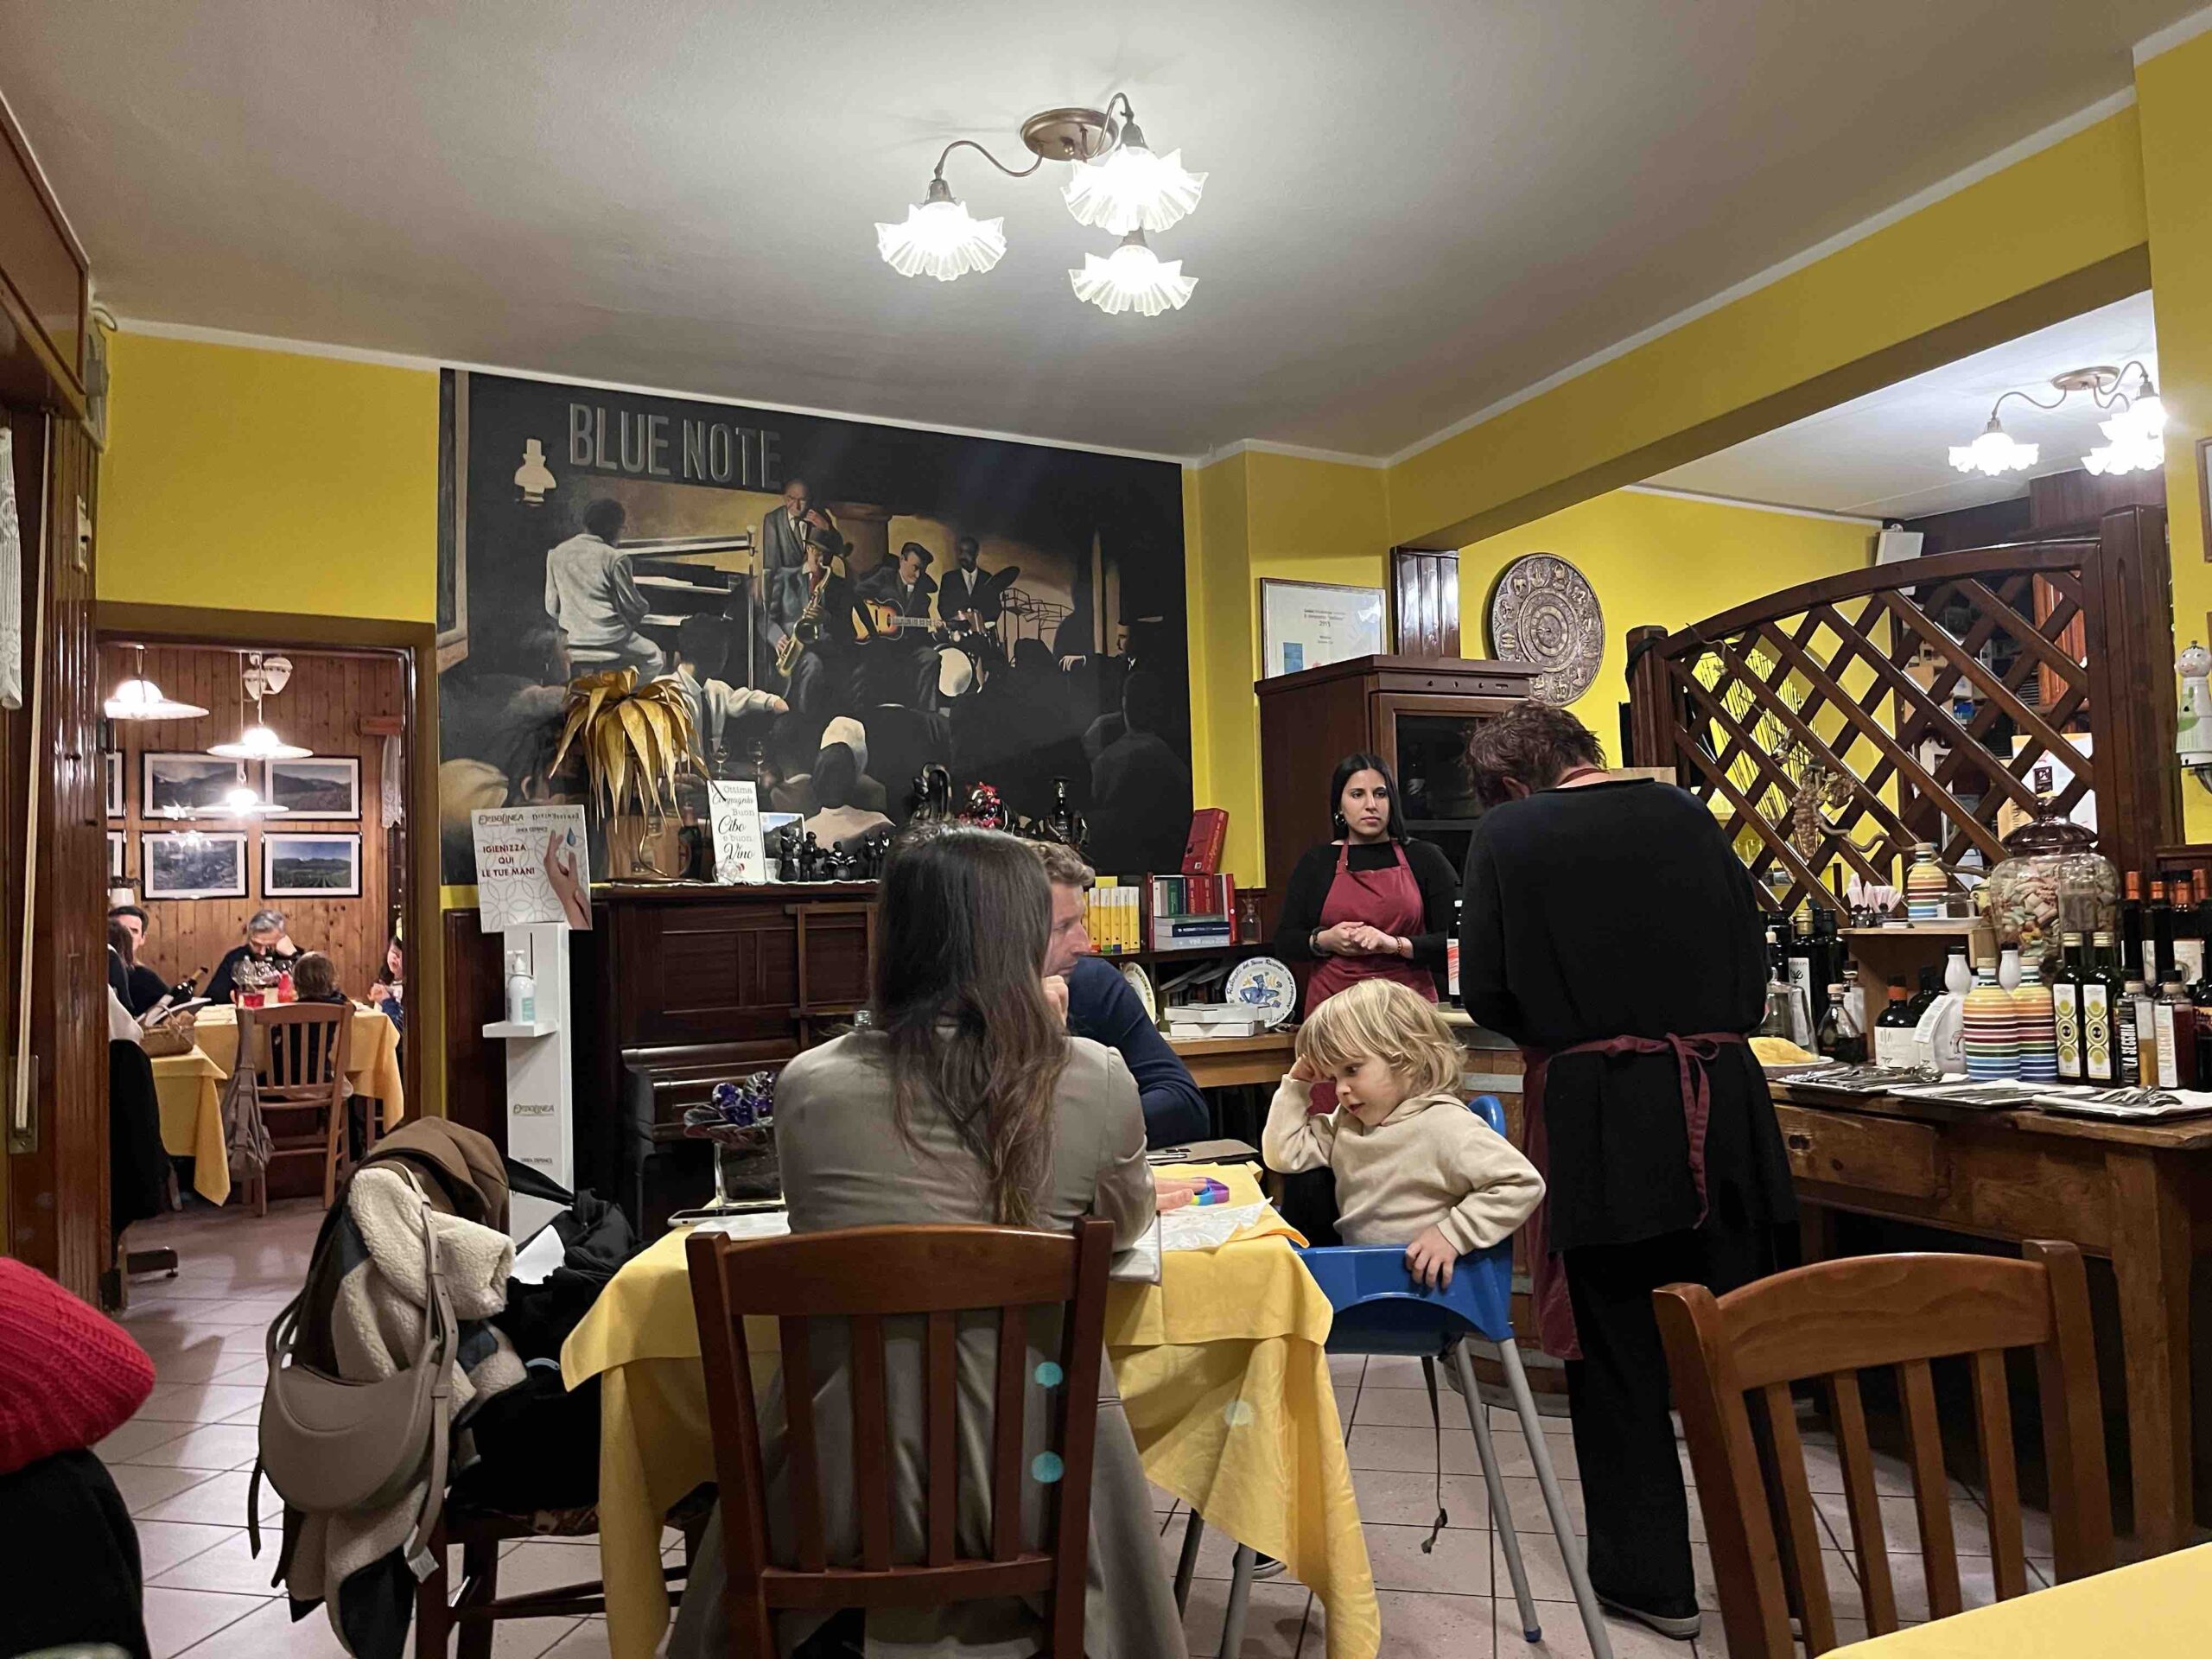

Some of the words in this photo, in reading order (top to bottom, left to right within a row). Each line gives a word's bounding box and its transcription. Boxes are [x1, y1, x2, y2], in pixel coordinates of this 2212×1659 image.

[569, 403, 671, 475] BLUE
[683, 418, 782, 489] NOTE
[732, 808, 755, 817] Buon
[718, 815, 746, 835] Cibo
[483, 843, 526, 854] IGIENIZZA
[724, 842, 754, 860] Vino
[499, 856, 514, 865] QUI
[512, 868, 535, 876] MANI
[2120, 1023, 2138, 1055] SECCHIA
[2121, 1057, 2139, 1067] LA
